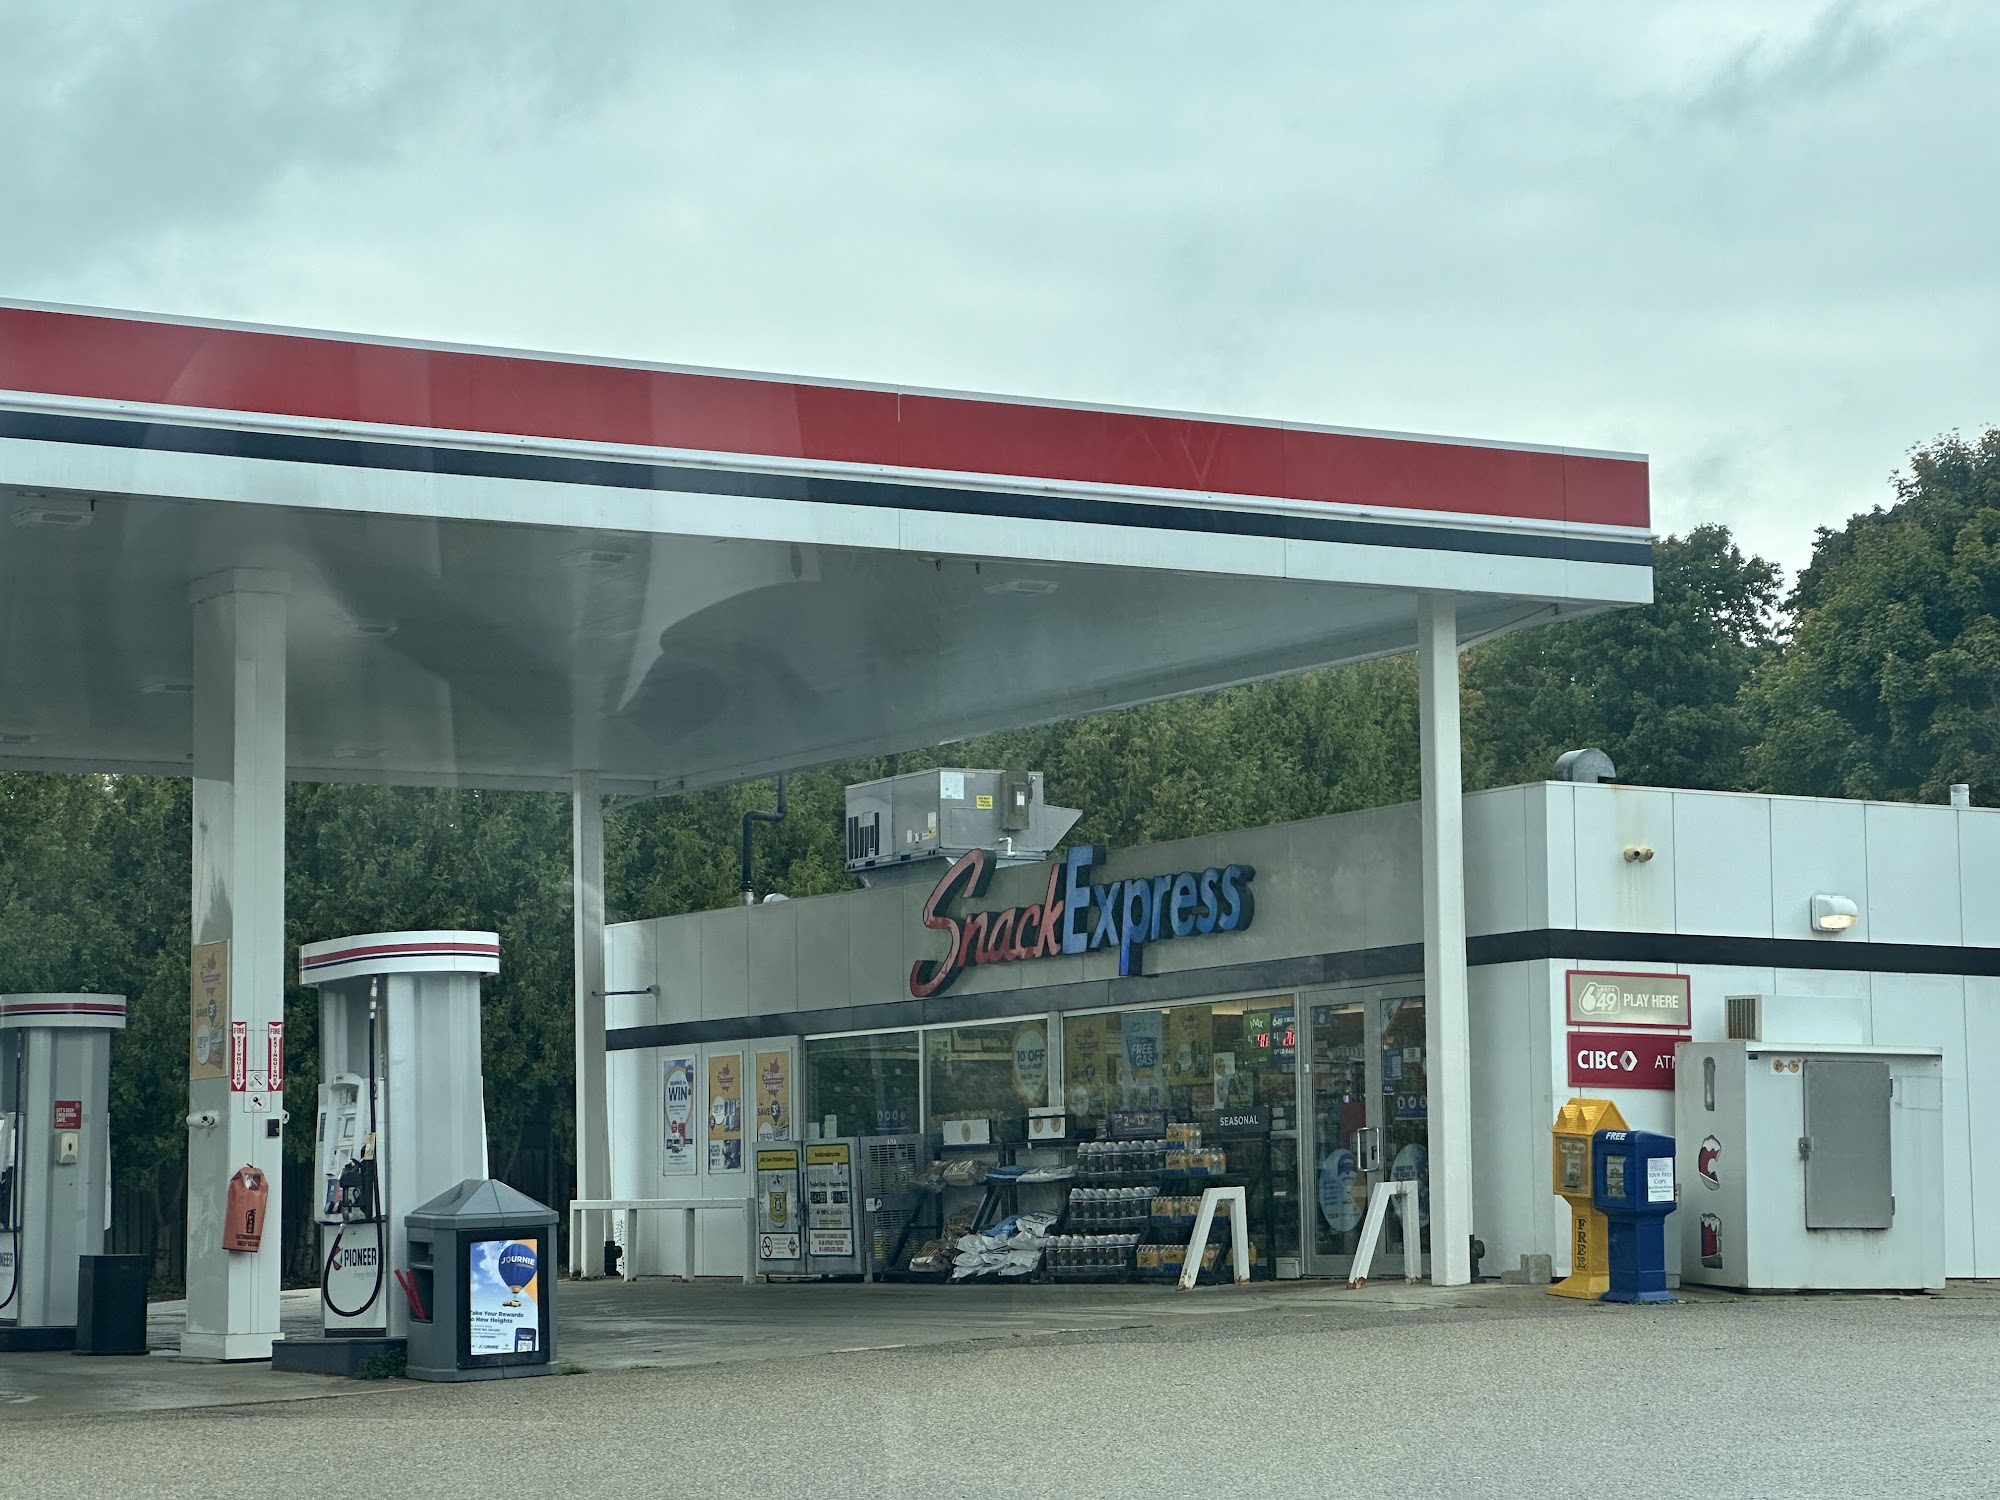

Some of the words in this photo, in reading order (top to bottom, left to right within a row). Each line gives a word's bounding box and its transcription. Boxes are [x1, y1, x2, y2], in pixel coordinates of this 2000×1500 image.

[910, 848, 1065, 998] Snack
[1062, 845, 1252, 977] Express
[1623, 993, 1650, 1008] PLAY
[1652, 995, 1679, 1009] HERE
[233, 1027, 245, 1035] FIRE
[269, 1027, 281, 1035] FIRE
[1028, 1049, 1045, 1061] OFF
[1131, 1043, 1153, 1056] FREE
[1135, 1055, 1153, 1066] GAS
[1577, 1050, 1619, 1070] CIBC
[1654, 1055, 1676, 1069] AT
[668, 1086, 687, 1101] WIN
[757, 1108, 771, 1116] SAVE
[1220, 1115, 1259, 1126] SEASONAL
[1605, 1131, 1627, 1141] FREE
[1577, 1218, 1587, 1269] FREE
[344, 1247, 377, 1266] PIONEER
[501, 1255, 536, 1266] JOURNIE
